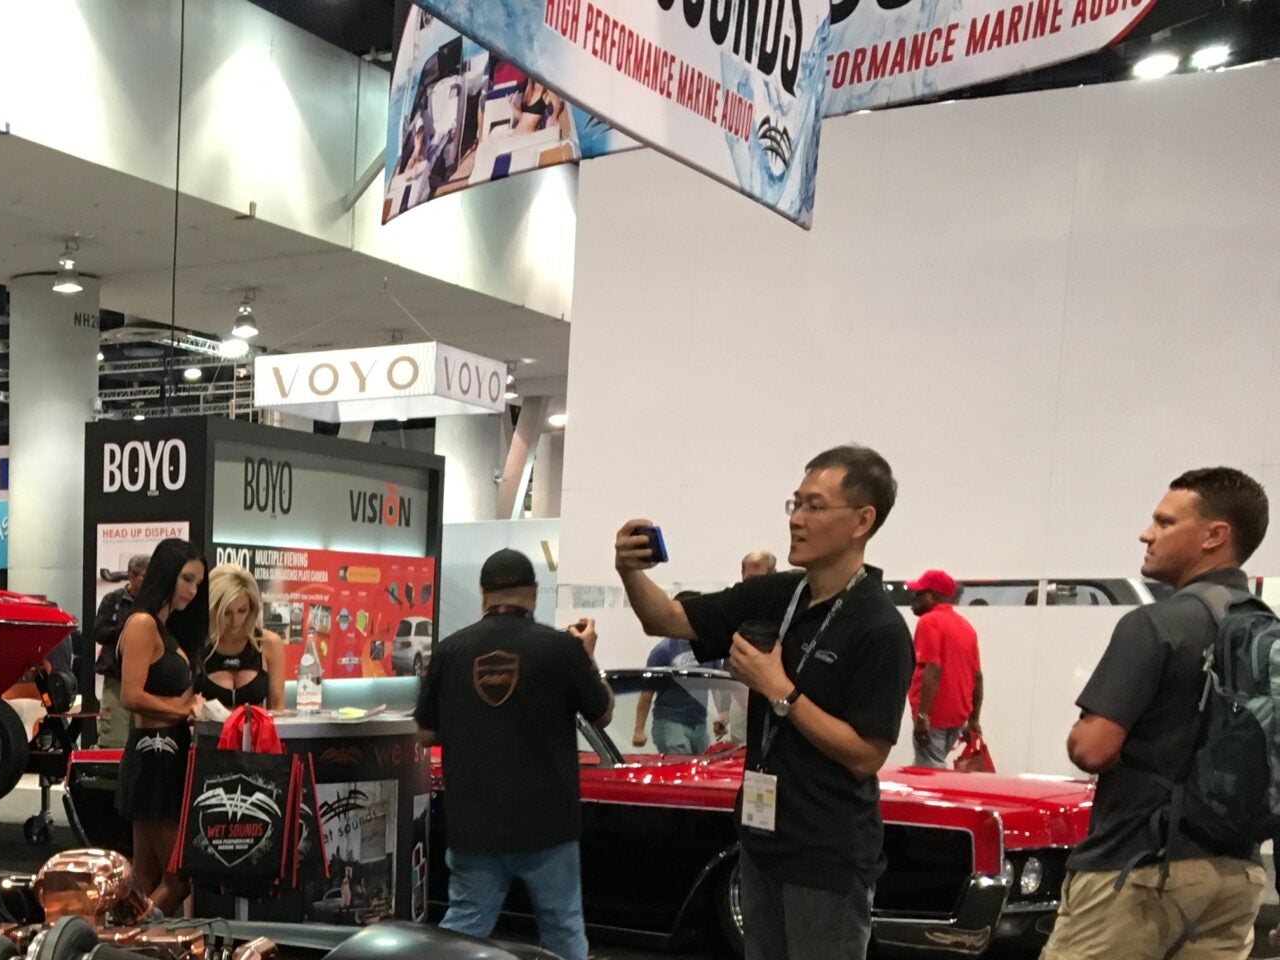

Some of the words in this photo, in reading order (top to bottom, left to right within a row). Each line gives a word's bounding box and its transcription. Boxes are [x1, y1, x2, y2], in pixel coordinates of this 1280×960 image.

[966, 0, 1062, 57] MARINE
[1071, 0, 1142, 27] AUD
[544, 0, 578, 43] HIGH
[583, 3, 676, 100] PERFORMANCE
[676, 60, 722, 124] MARINE
[720, 89, 754, 143] AUDIO
[272, 355, 420, 398] VOYO
[444, 356, 501, 403] VOYO
[103, 438, 186, 493] BOYO
[244, 457, 293, 515] BOYO
[349, 481, 411, 527] VISION
[102, 528, 128, 538] HEAD
[131, 528, 142, 538] UP
[145, 527, 183, 537] DISPLAY
[255, 549, 283, 566] MULTIPLE
[284, 551, 308, 568] VIEWING
[207, 824, 224, 838] WET
[228, 823, 264, 837] SOUNDS
